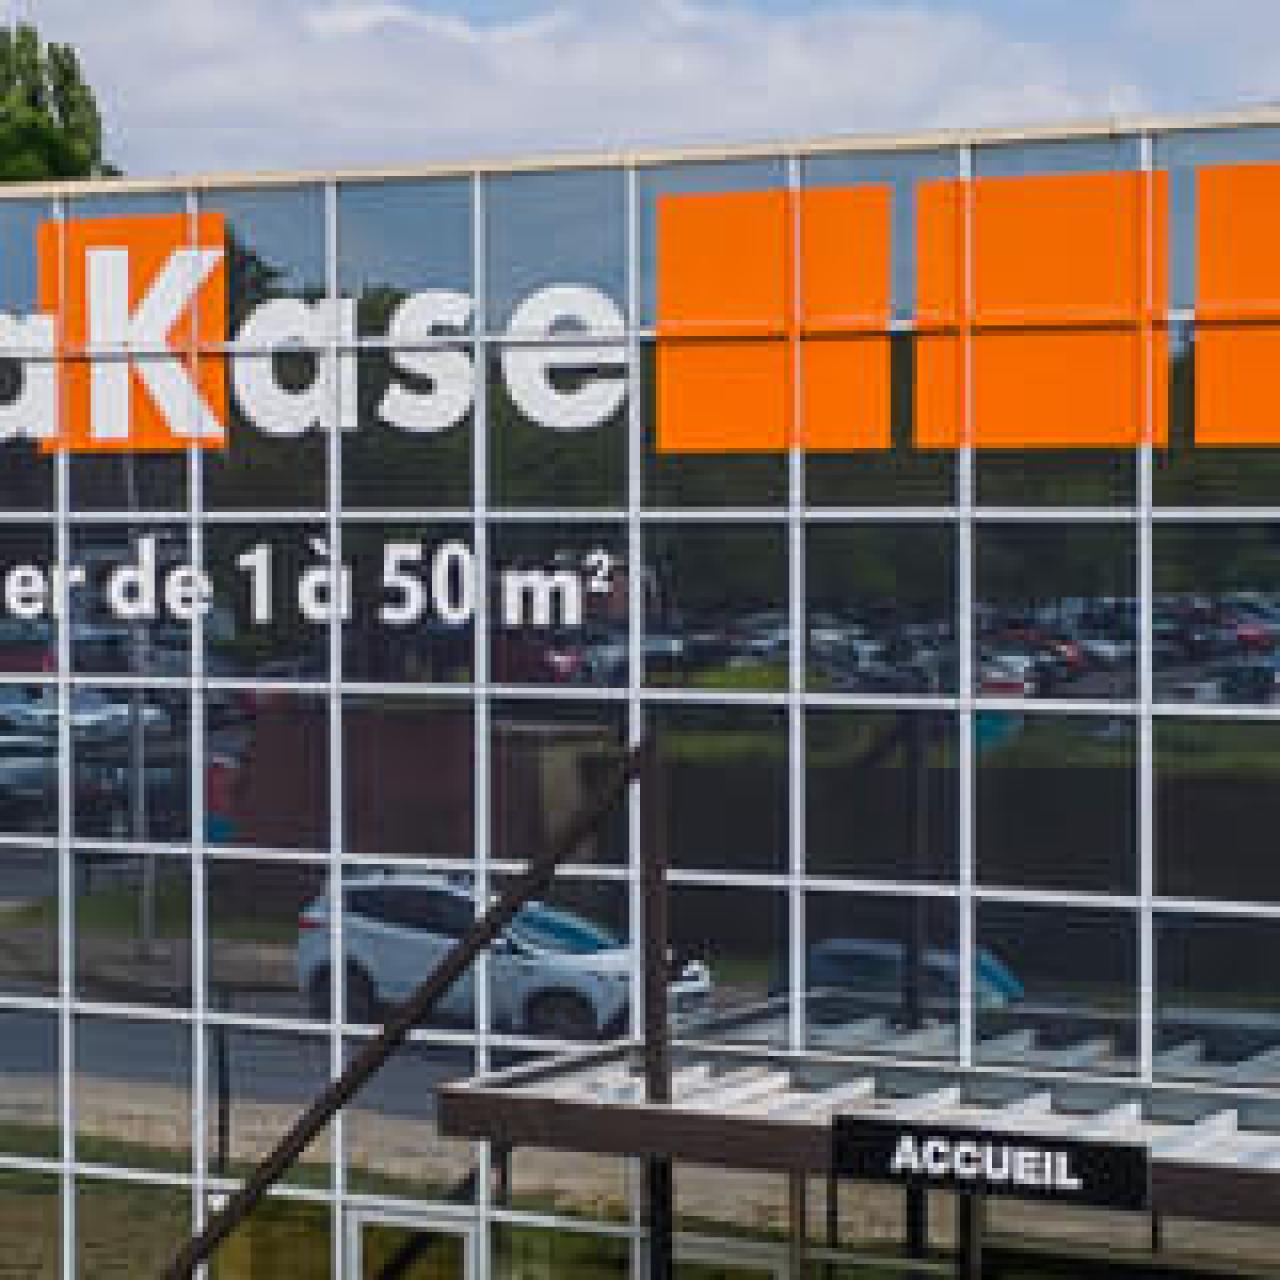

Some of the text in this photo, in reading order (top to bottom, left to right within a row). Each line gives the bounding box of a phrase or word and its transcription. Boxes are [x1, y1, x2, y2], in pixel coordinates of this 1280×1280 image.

[106, 534, 216, 620] de
[234, 542, 274, 624] 1
[297, 536, 353, 624] à
[378, 541, 478, 625] 50
[889, 1134, 1084, 1191] ACCUEIL
